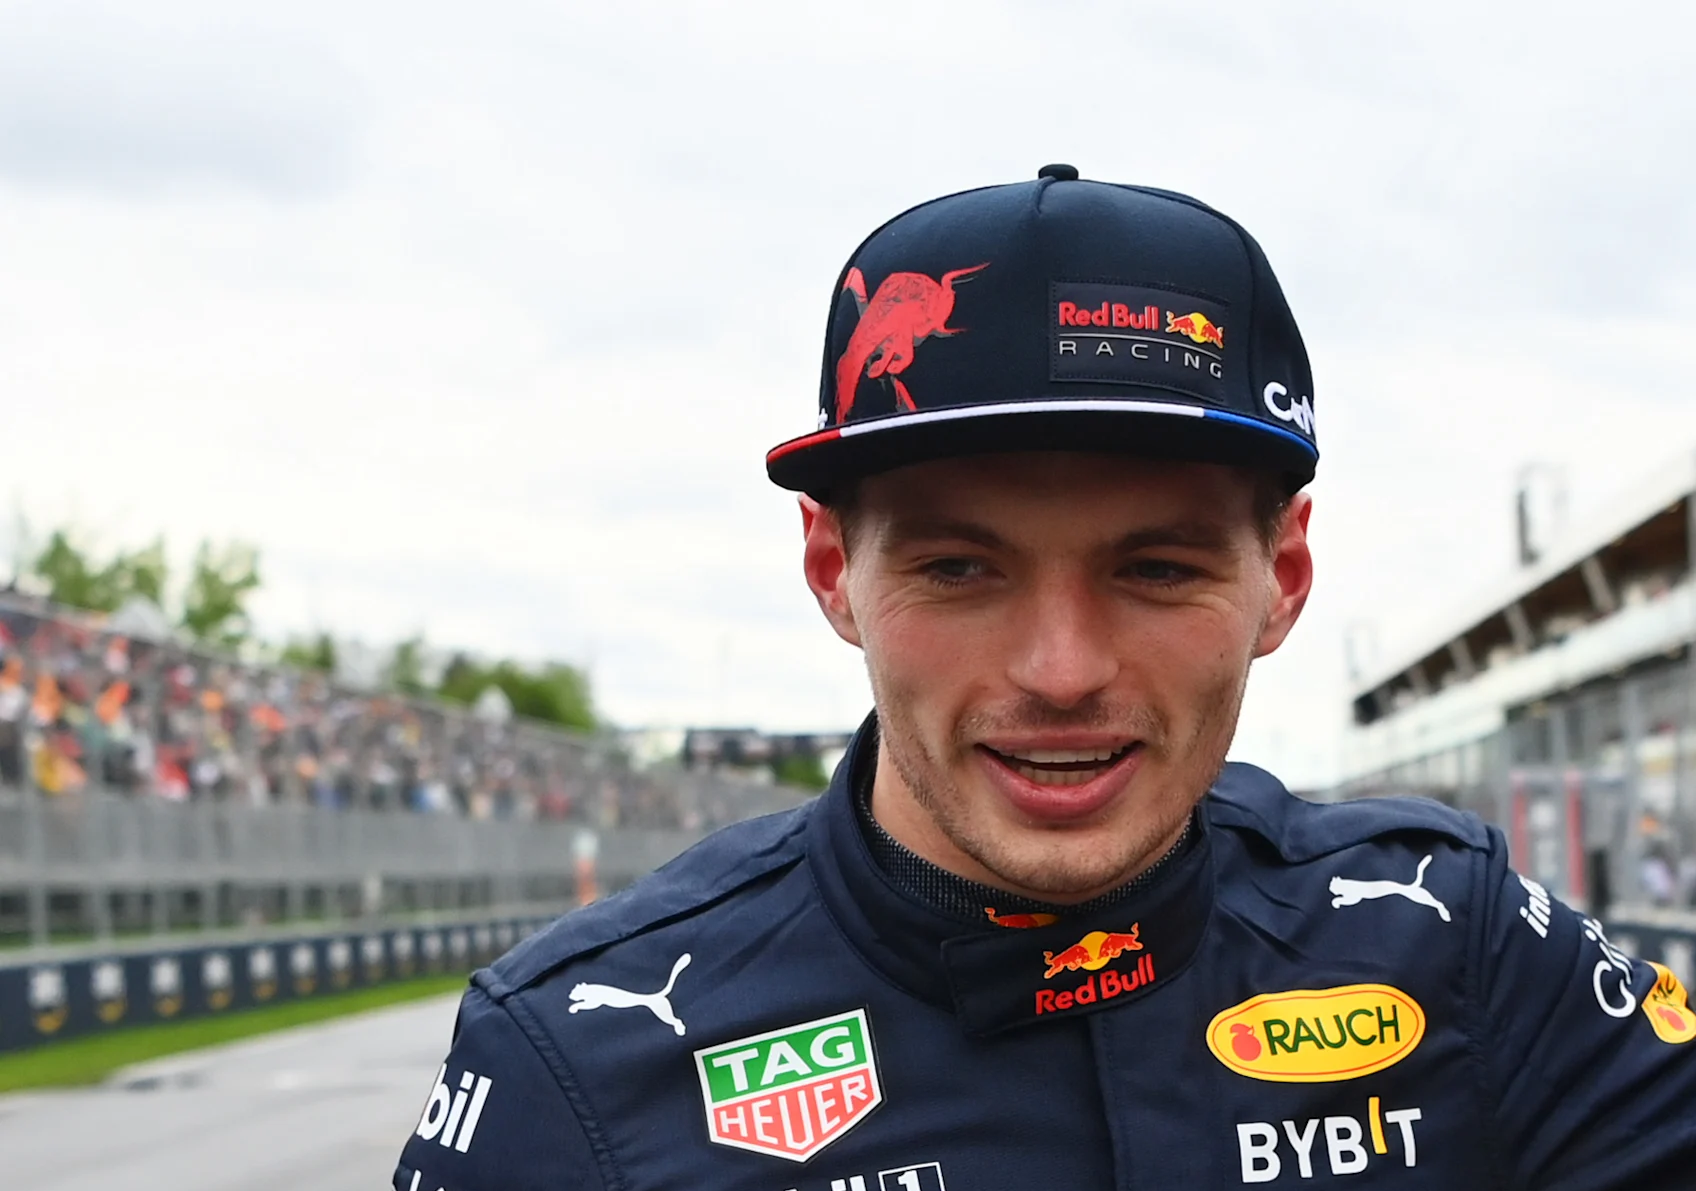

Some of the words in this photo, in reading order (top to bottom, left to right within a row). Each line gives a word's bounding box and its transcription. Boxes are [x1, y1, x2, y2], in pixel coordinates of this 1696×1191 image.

[1059, 301, 1110, 327] Red
[1111, 303, 1160, 330] Bull
[1058, 340, 1223, 379] RACING
[1034, 980, 1098, 1015] Red
[1099, 953, 1156, 998] Bull
[711, 1025, 856, 1093] TAG
[1263, 1004, 1401, 1056] RAUCH
[720, 1074, 869, 1150] HEUER
[1236, 1096, 1423, 1184] BYBIT
